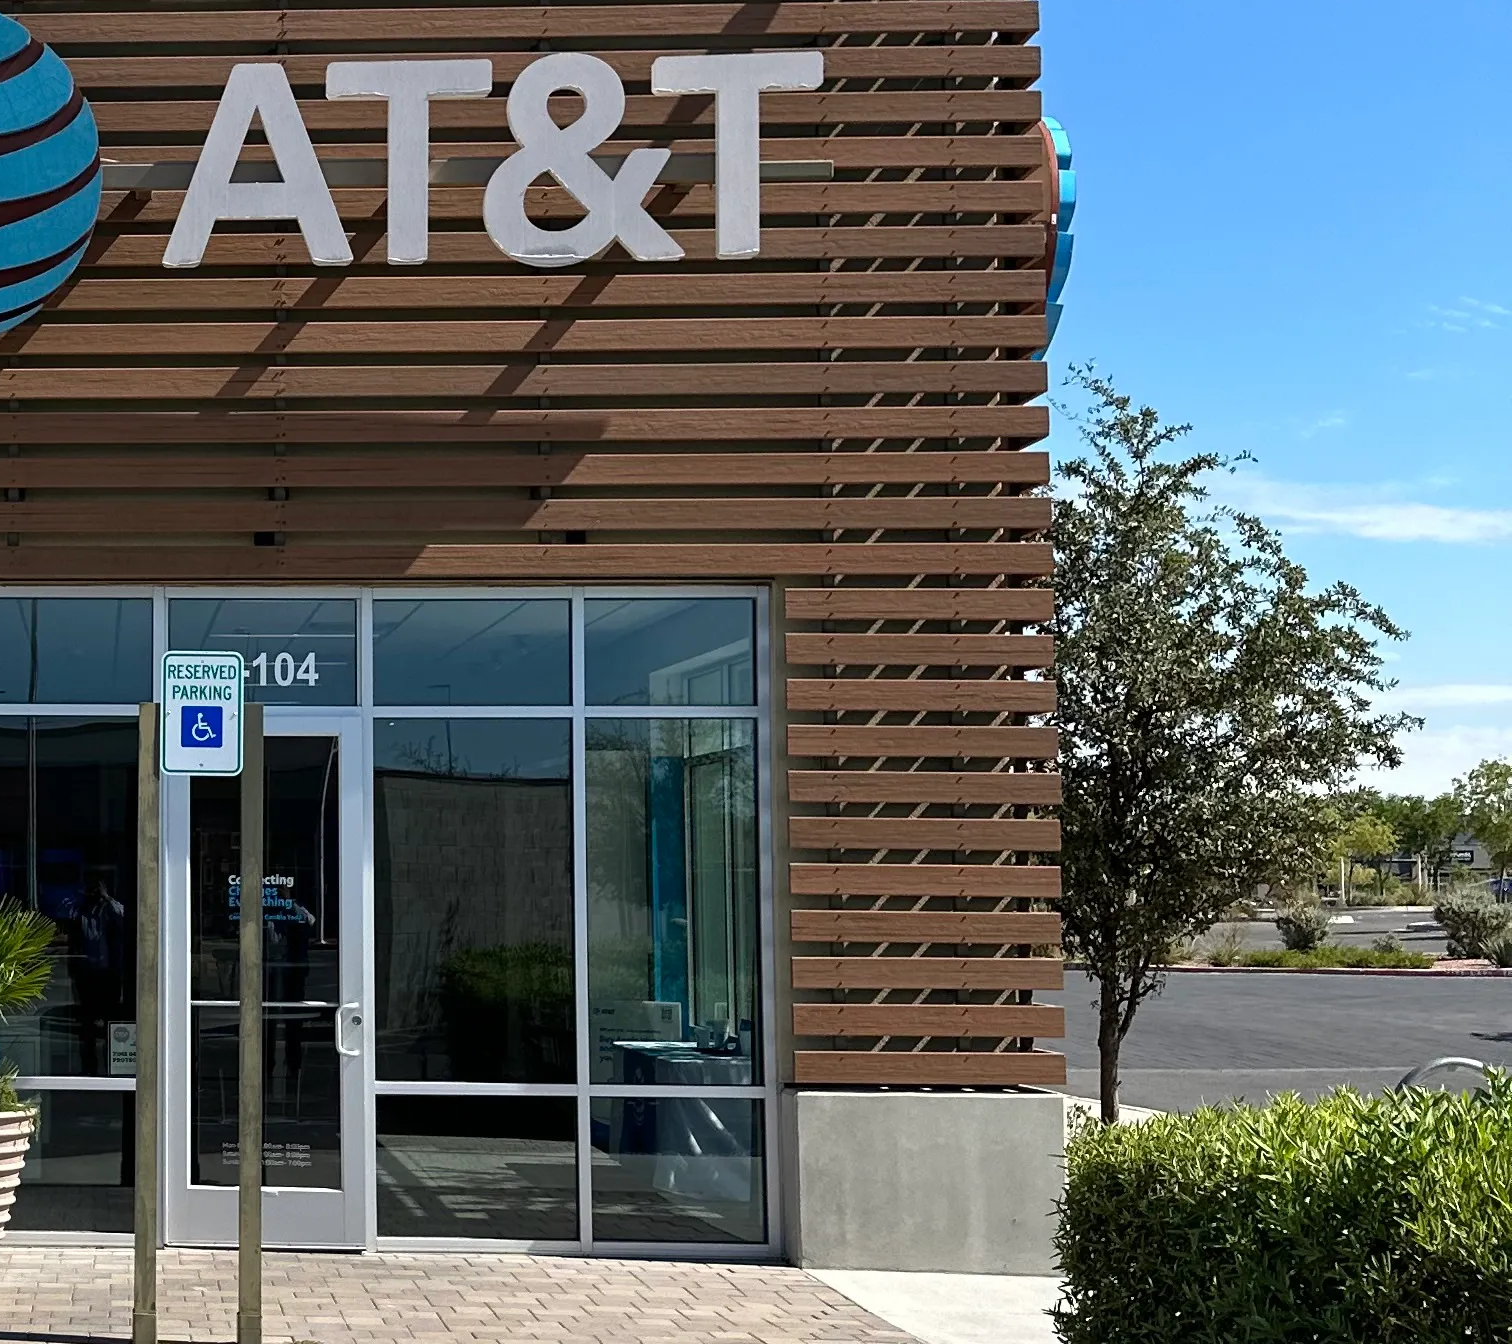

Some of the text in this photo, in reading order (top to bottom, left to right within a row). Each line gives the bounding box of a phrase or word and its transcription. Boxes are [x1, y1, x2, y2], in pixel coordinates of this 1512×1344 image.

[161, 50, 826, 269] AT&T
[167, 664, 237, 680] RESERVED
[172, 685, 232, 701] PARKING
